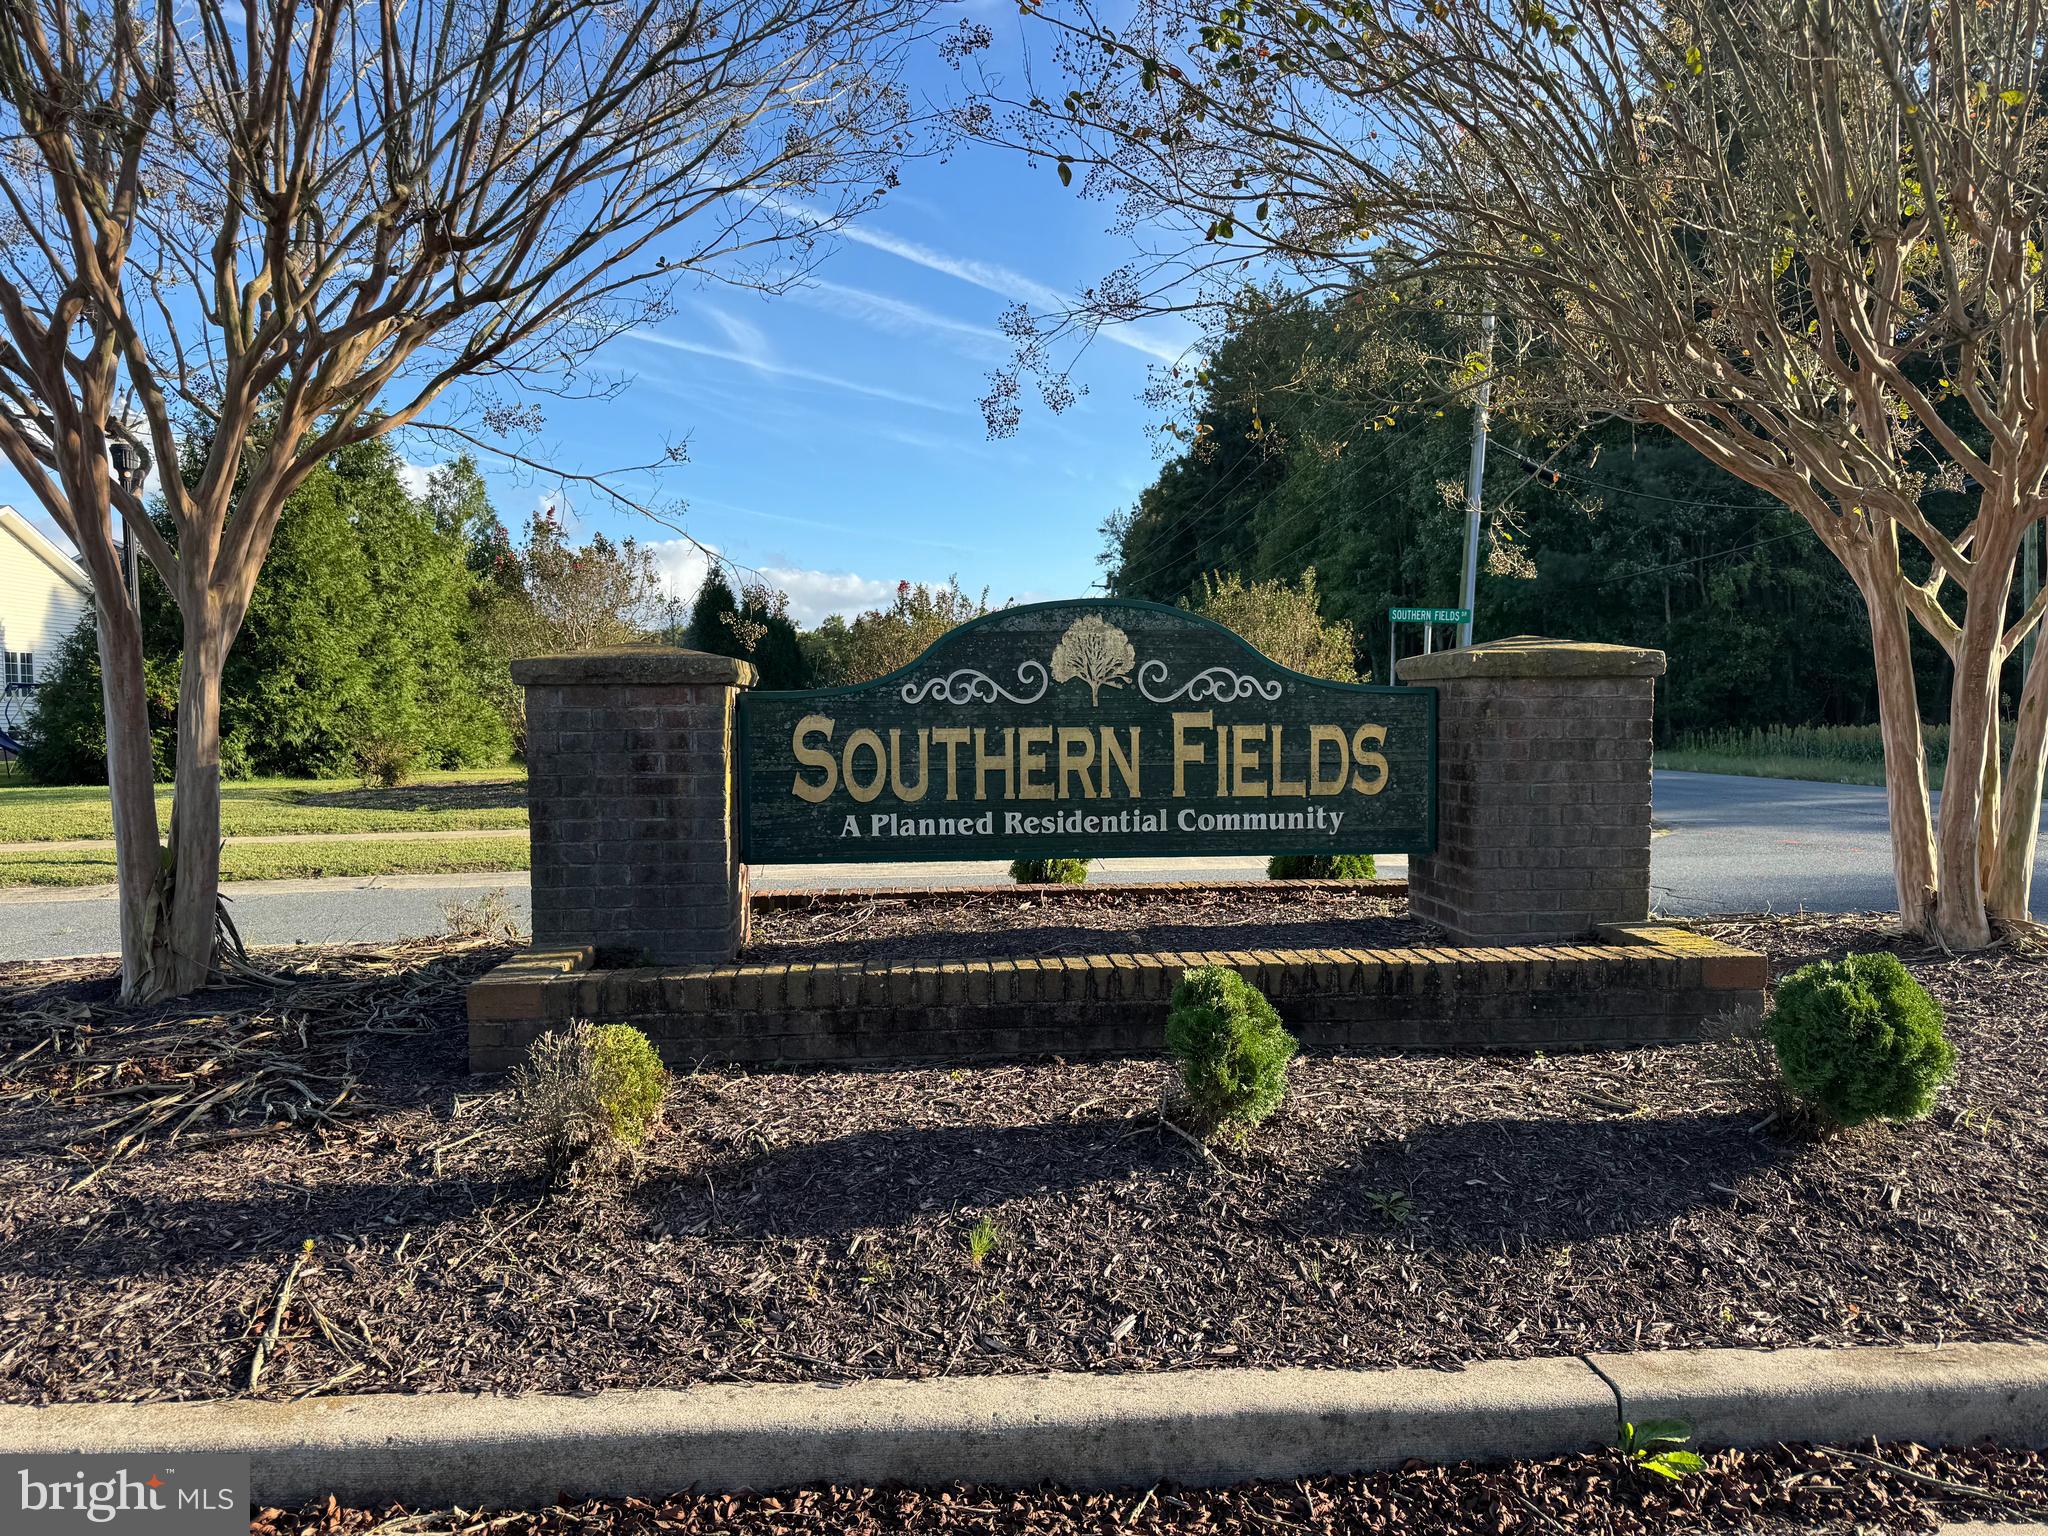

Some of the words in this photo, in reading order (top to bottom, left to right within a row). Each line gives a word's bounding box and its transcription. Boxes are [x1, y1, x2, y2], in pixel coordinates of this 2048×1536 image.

[1392, 609, 1431, 621] SOUTHERN
[1434, 610, 1460, 622] FIELDS
[792, 714, 1141, 802] SOUTHERN
[1172, 710, 1389, 798] FIELDS
[840, 814, 861, 837] A
[871, 811, 994, 836] Planned
[1004, 808, 1168, 835] Residential
[1177, 806, 1344, 835] Community
